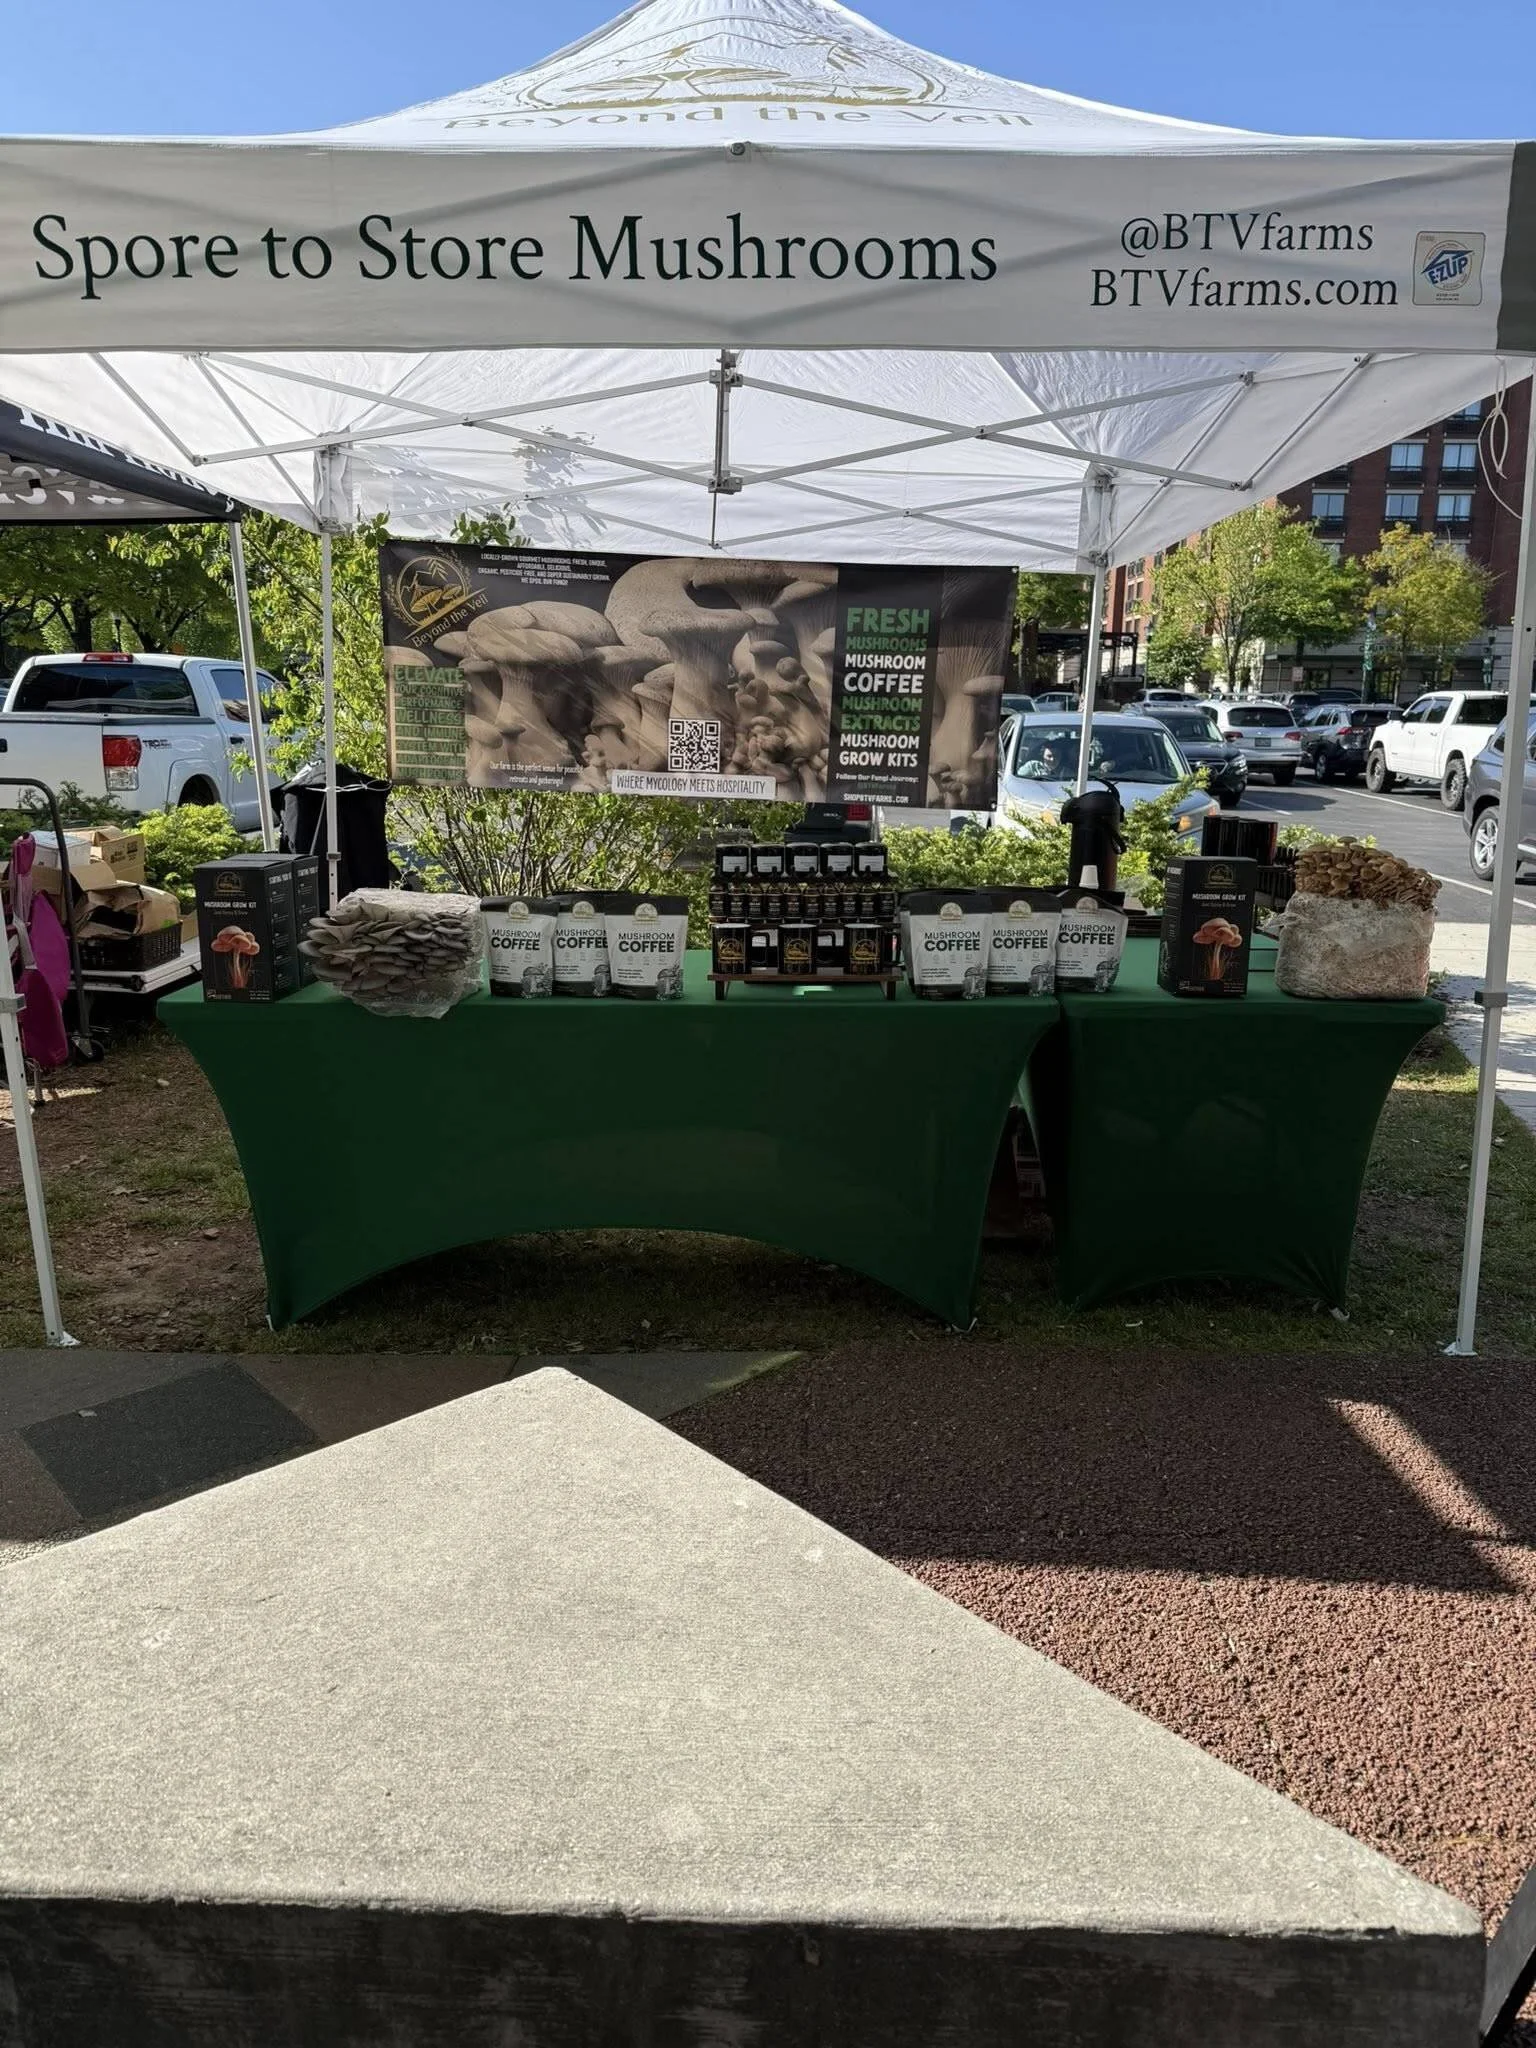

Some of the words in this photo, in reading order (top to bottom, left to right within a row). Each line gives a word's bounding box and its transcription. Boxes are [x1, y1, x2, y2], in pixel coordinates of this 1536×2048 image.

[445, 107, 724, 129] Beyond
[756, 106, 871, 123] the
[899, 110, 1033, 126] Veil
[1121, 211, 1374, 258] @BTVfarms
[33, 214, 239, 300] Spore
[260, 227, 333, 280] to
[358, 214, 544, 280] Store
[569, 213, 999, 281] Mushrooms
[1090, 267, 1399, 307] BTVfarms.com
[410, 618, 452, 648] Beyond
[449, 607, 469, 624] the
[465, 592, 489, 612] Veil
[846, 607, 930, 634] FRESH
[846, 636, 928, 652] MUSHROOMS
[844, 653, 927, 670] MUSHROOM
[395, 666, 464, 683] ELEVATE
[420, 685, 466, 697] COGNITIVE
[843, 672, 925, 694] COFFEE
[842, 696, 923, 712] MUSHROOM
[840, 713, 921, 731] EXTRACTS
[424, 727, 466, 741] IMMUNE
[840, 733, 920, 749] MUSHROOM
[839, 750, 884, 766] GROW
[887, 752, 918, 767] KITS
[616, 775, 645, 790] WHERE
[646, 776, 688, 792] MYCOLOGY
[689, 778, 715, 793] MEETS
[716, 779, 766, 794] HOSPITALITY
[835, 772, 857, 780] Follow
[871, 774, 889, 783] Fungi
[491, 929, 541, 939] MUSHROOM
[924, 930, 981, 940] MUSHROOM
[992, 928, 1048, 937] MUSHROOM
[1059, 923, 1116, 933] MUSHROOM
[490, 936, 541, 951] COFFEE
[556, 936, 608, 949] COFFEE
[618, 932, 675, 941] MUSHROOM
[992, 936, 1048, 950] COFFEE
[1058, 931, 1115, 946] COFFEE
[618, 940, 675, 953] COFFEE
[924, 938, 981, 952] COFFEE
